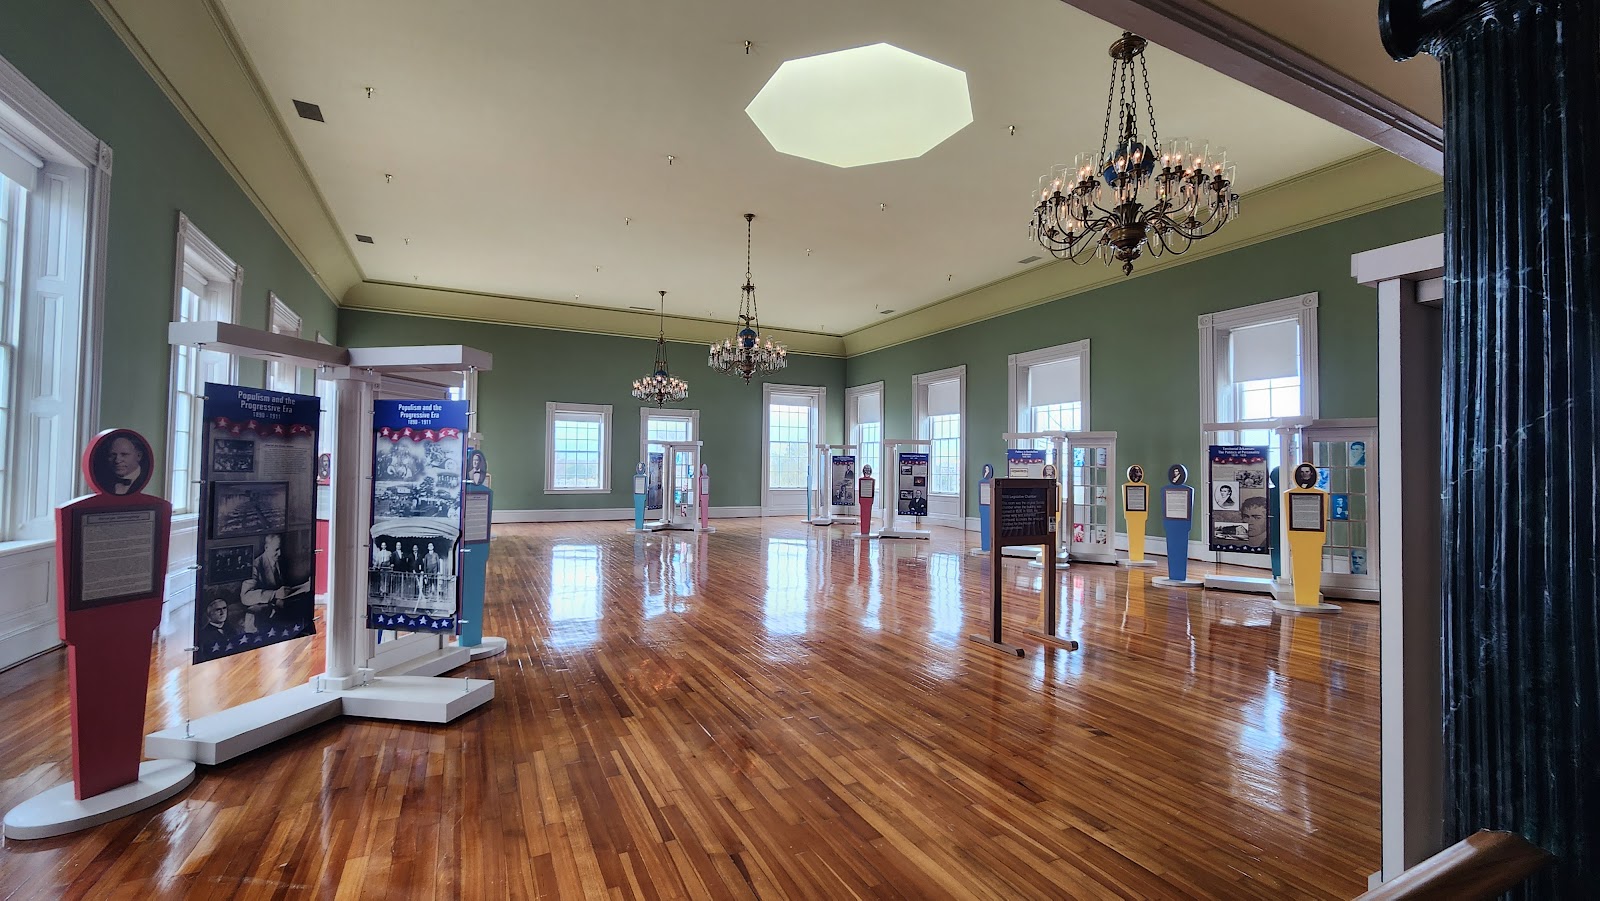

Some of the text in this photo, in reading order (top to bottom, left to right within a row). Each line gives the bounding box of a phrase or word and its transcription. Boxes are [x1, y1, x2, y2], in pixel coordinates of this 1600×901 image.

[238, 390, 270, 402] Populism
[286, 397, 296, 405] the
[240, 400, 292, 413] Progressive Era
[398, 404, 421, 412] Populism
